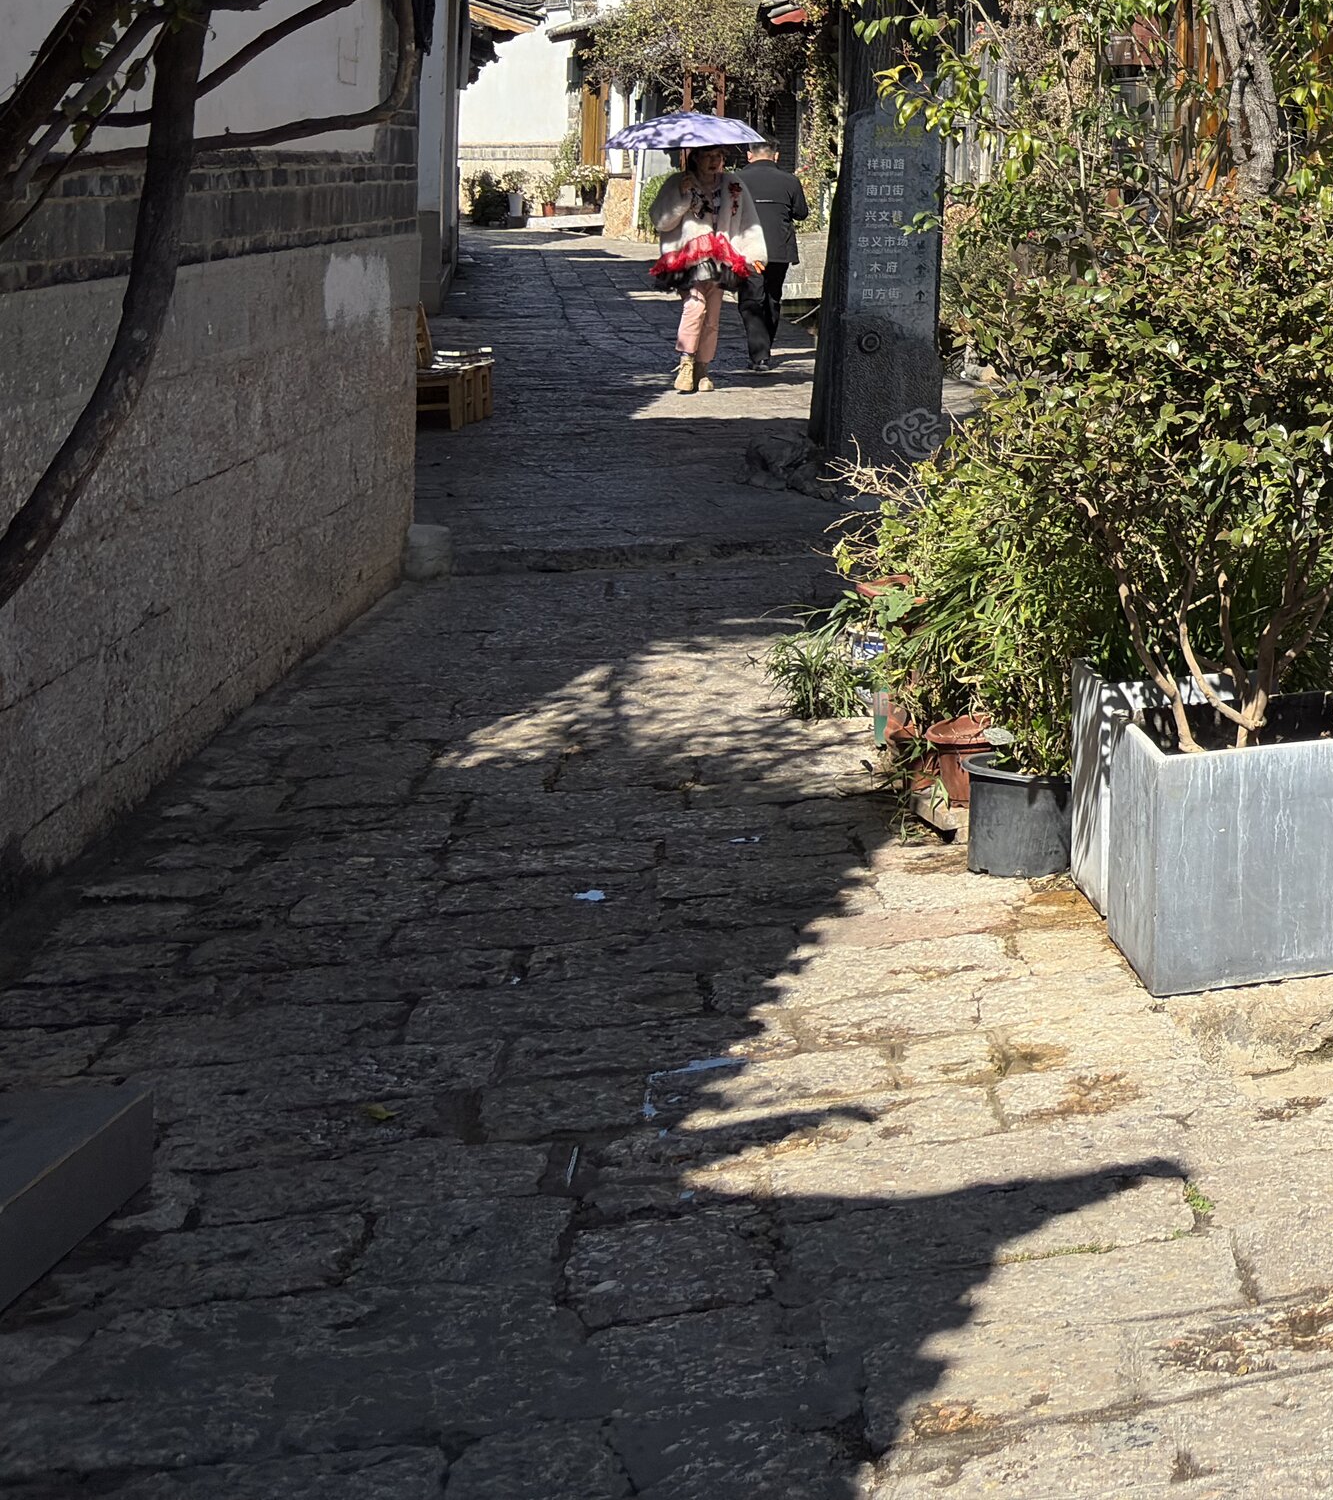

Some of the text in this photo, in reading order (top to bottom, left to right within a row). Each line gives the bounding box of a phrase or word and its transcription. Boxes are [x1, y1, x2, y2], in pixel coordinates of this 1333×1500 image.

[867, 158, 905, 170] 祥和路
[866, 185, 904, 196] 南门街
[858, 236, 909, 247] 忠义市场
[869, 261, 898, 273] 木府
[862, 288, 900, 300] 四方街
